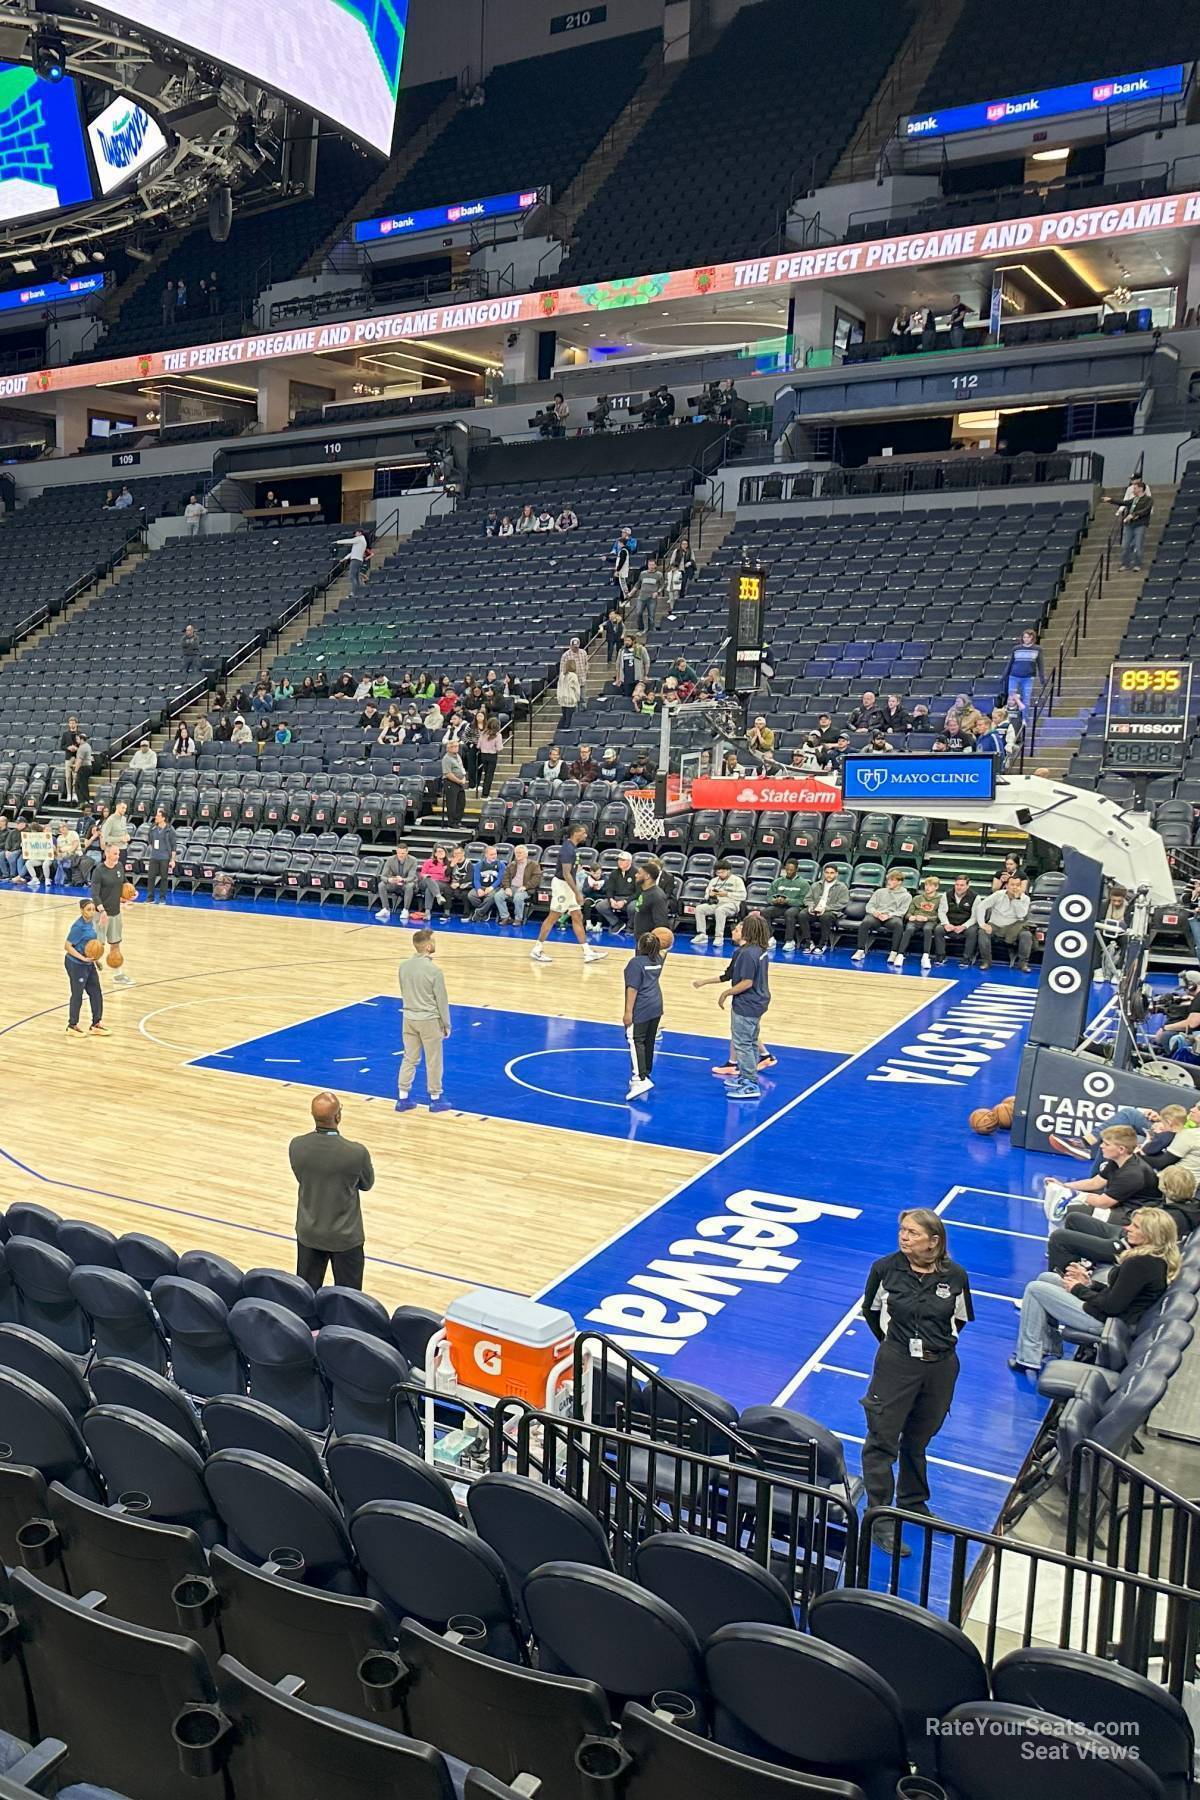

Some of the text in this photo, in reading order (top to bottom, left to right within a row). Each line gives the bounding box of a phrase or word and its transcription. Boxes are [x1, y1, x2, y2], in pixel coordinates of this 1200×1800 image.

[566, 11, 591, 30] 210
[1112, 78, 1148, 95] bank
[1005, 98, 1039, 115] bank
[460, 203, 484, 217] bank
[392, 217, 414, 229] bank
[734, 261, 770, 286] THE
[774, 247, 862, 280] PERFECT
[866, 231, 975, 267] PREGAME
[981, 221, 1033, 254] AND
[1039, 200, 1179, 242] POSTGAME
[163, 299, 523, 371] THE PERFECT PREGAME AND POSTGAME HANGOUT
[951, 375, 979, 389] 112
[610, 396, 631, 409] 111
[324, 443, 341, 454] 110
[119, 455, 133, 465] 109
[1121, 670, 1180, 691] 89:35
[1129, 724, 1183, 734] TISSOT
[891, 773, 979, 784] MAYO CLINIC
[866, 982, 1039, 1086] MINNESOTA
[473, 1340, 502, 1376] G
